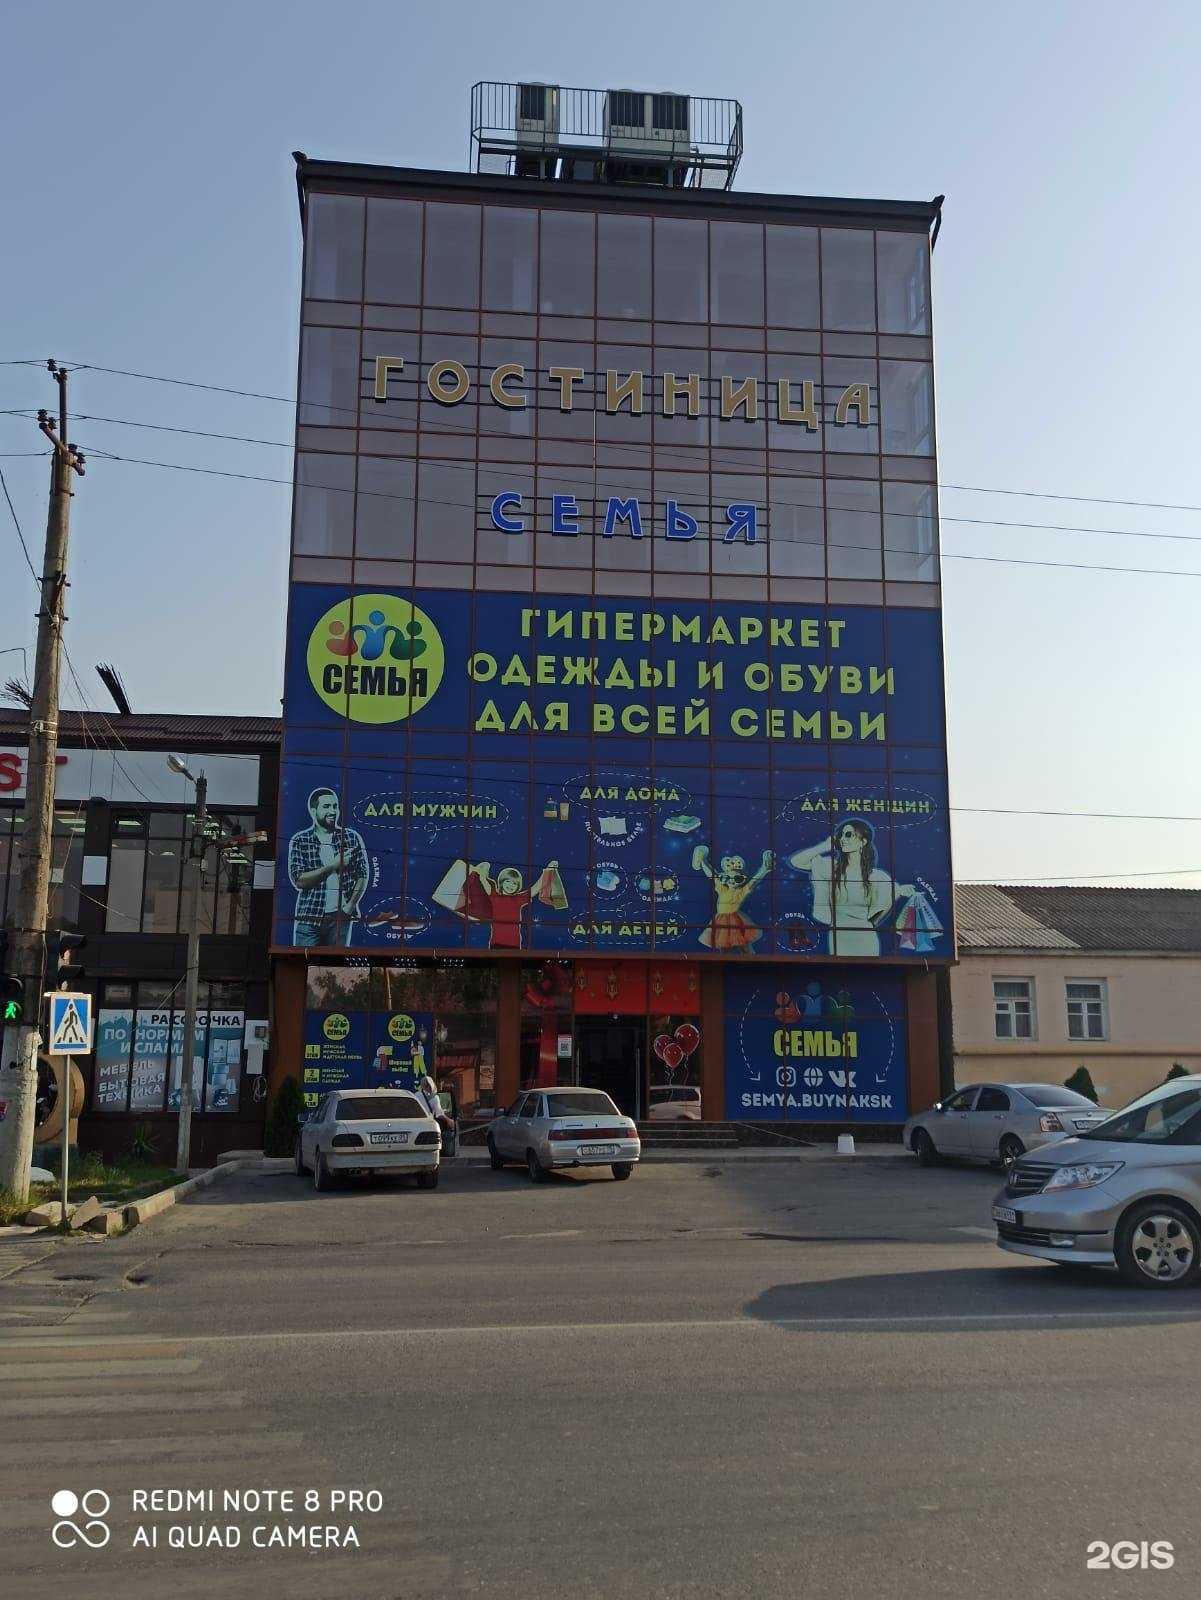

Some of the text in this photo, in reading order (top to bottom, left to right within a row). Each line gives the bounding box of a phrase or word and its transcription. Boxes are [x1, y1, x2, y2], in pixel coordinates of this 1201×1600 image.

[374, 355, 873, 430] ГОСТИНИЦА
[490, 491, 759, 543] СЕМЬЯ
[520, 607, 847, 649] ГИПЕРМАРКЕТ
[322, 663, 428, 697] СЕМЬЯ
[466, 652, 895, 697] ОДЕЖДЫ И ОБУВИ
[474, 698, 887, 742] ДЛЯ ВСЕЙ СЕМЬИ
[579, 786, 680, 802] ДЛЯ ДОМА
[800, 798, 930, 814] ДЛЯ ЖЕНЩИН
[364, 802, 498, 819] ДЛЯ МУЖЧИН
[572, 917, 679, 936] ДЛЯ ДЕТЕЙ
[104, 1028, 127, 1040] ПО
[773, 1029, 859, 1058] СЕМЬЯ
[741, 1092, 893, 1109] SEMYA.BUYNAKSK
